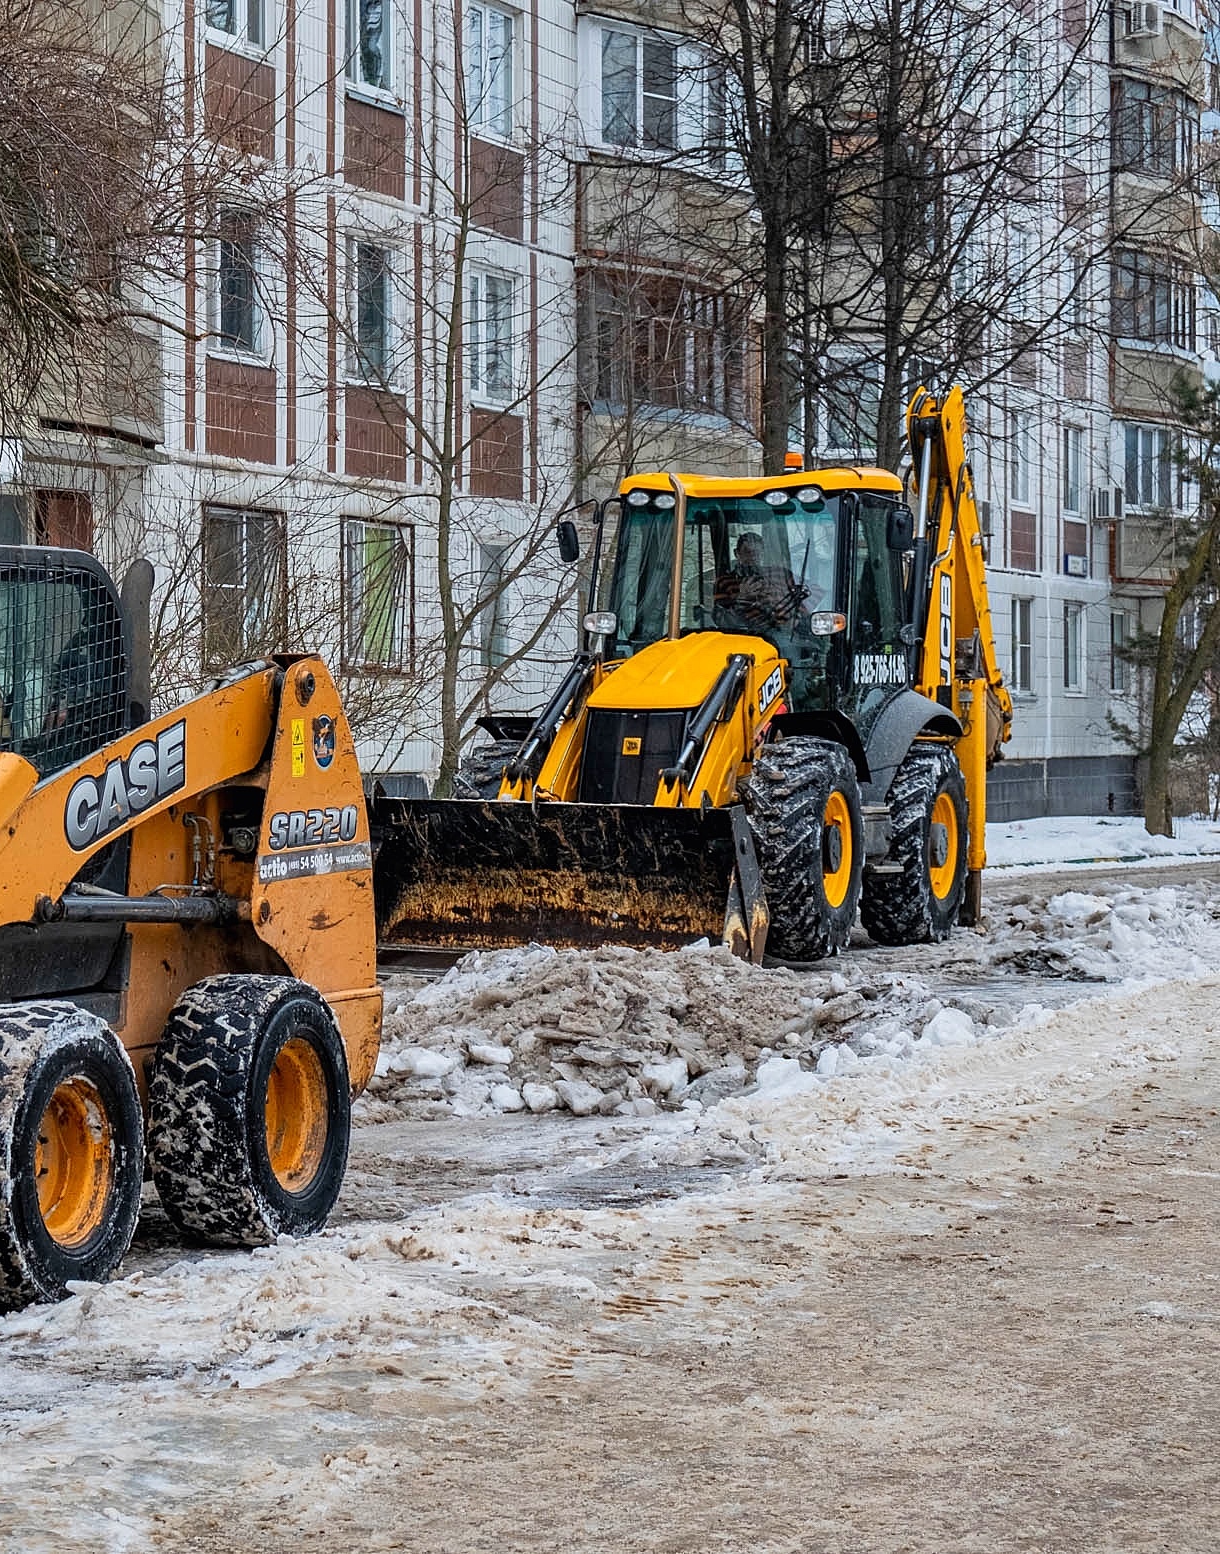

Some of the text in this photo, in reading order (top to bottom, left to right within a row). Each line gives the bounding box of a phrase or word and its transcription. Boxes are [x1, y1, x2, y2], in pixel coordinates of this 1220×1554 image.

[940, 574, 951, 687] JCB
[759, 666, 782, 713] JCB
[854, 655, 860, 684] 8
[64, 718, 186, 850] CASE
[269, 804, 357, 850] SR220
[260, 857, 288, 879] actio
